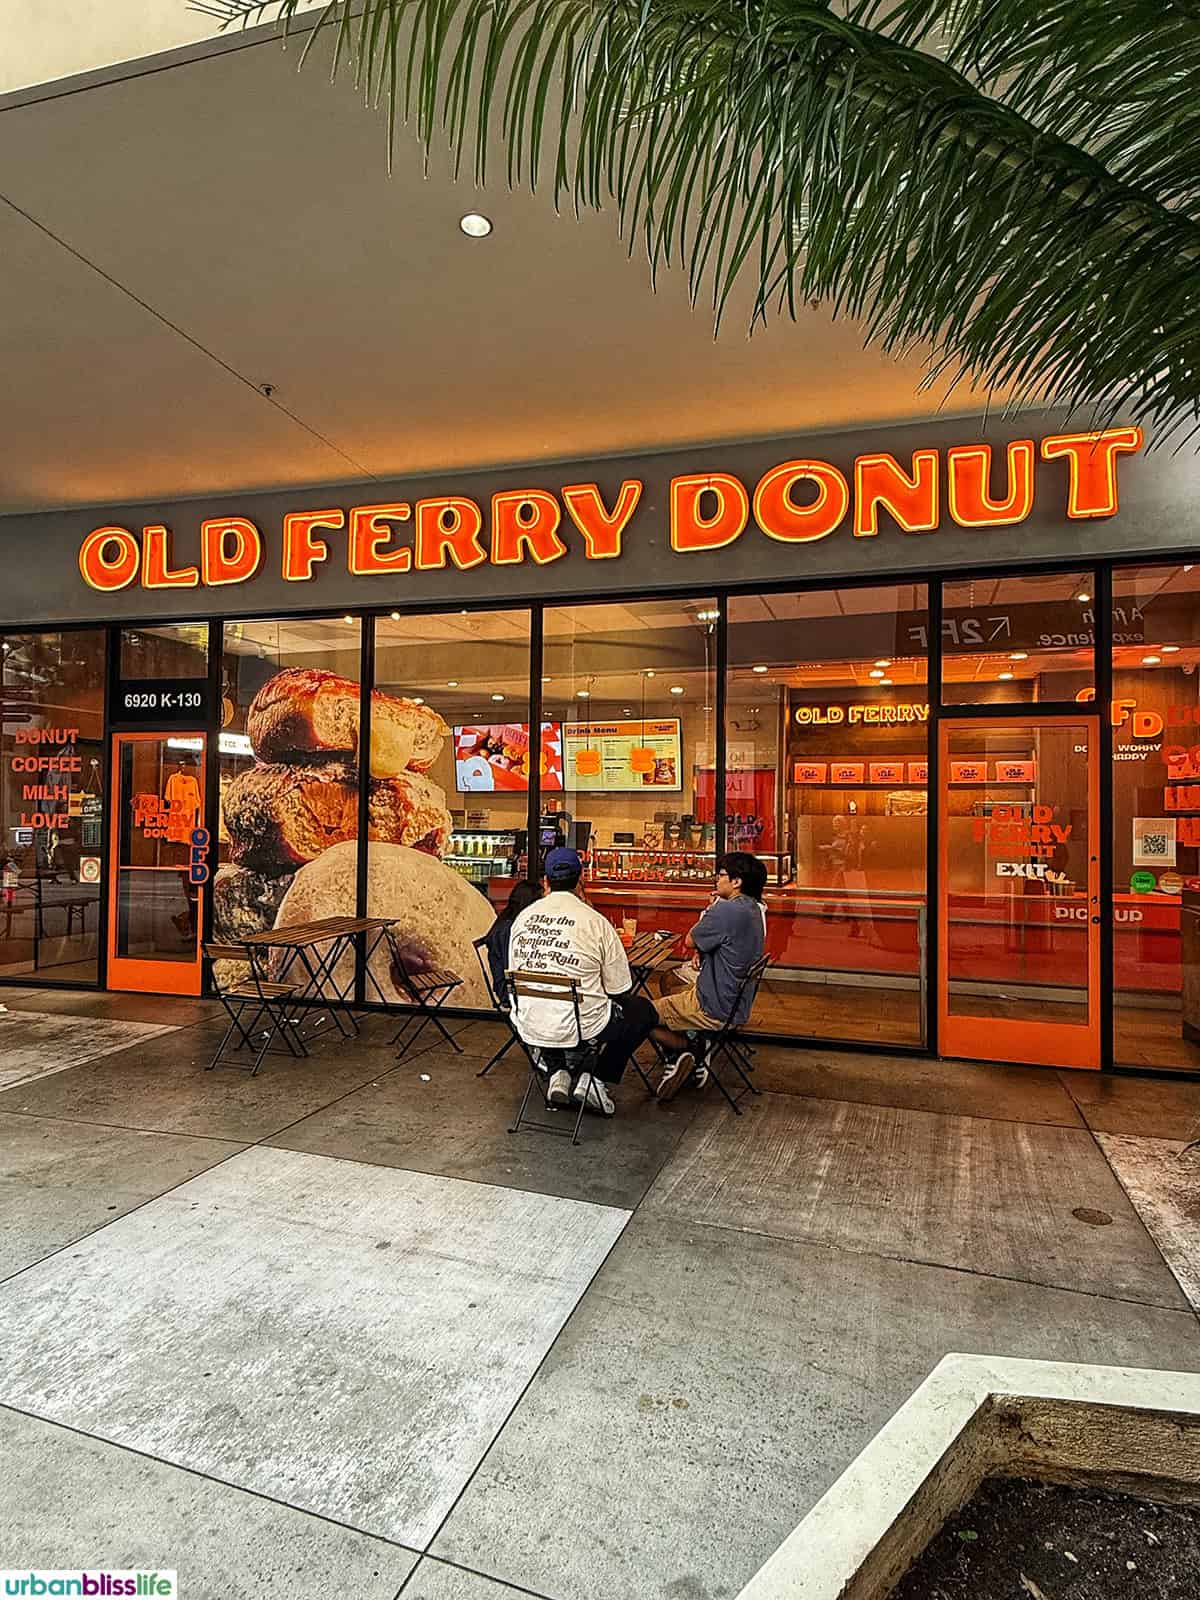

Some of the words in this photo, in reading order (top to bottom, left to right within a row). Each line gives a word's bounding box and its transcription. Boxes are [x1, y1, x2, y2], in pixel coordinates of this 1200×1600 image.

[79, 516, 261, 592] OLD
[282, 480, 643, 582] FERRY
[670, 426, 1144, 553] DONUT
[124, 693, 157, 707] 6920
[160, 692, 202, 707] K-130
[795, 707, 844, 724] OLD
[848, 704, 930, 724] FERRY
[15, 727, 79, 745] DONUT
[593, 726, 618, 734] Menu
[11, 756, 82, 773] COFFEE
[20, 813, 70, 829] LOVE
[996, 862, 1048, 877] EXIT
[556, 915, 576, 927] the
[1055, 907, 1089, 920] PIC
[1113, 909, 1144, 922] UP
[527, 924, 563, 937] Roses
[529, 948, 548, 961] the
[546, 950, 580, 966] Rain
[534, 960, 548, 970] so
